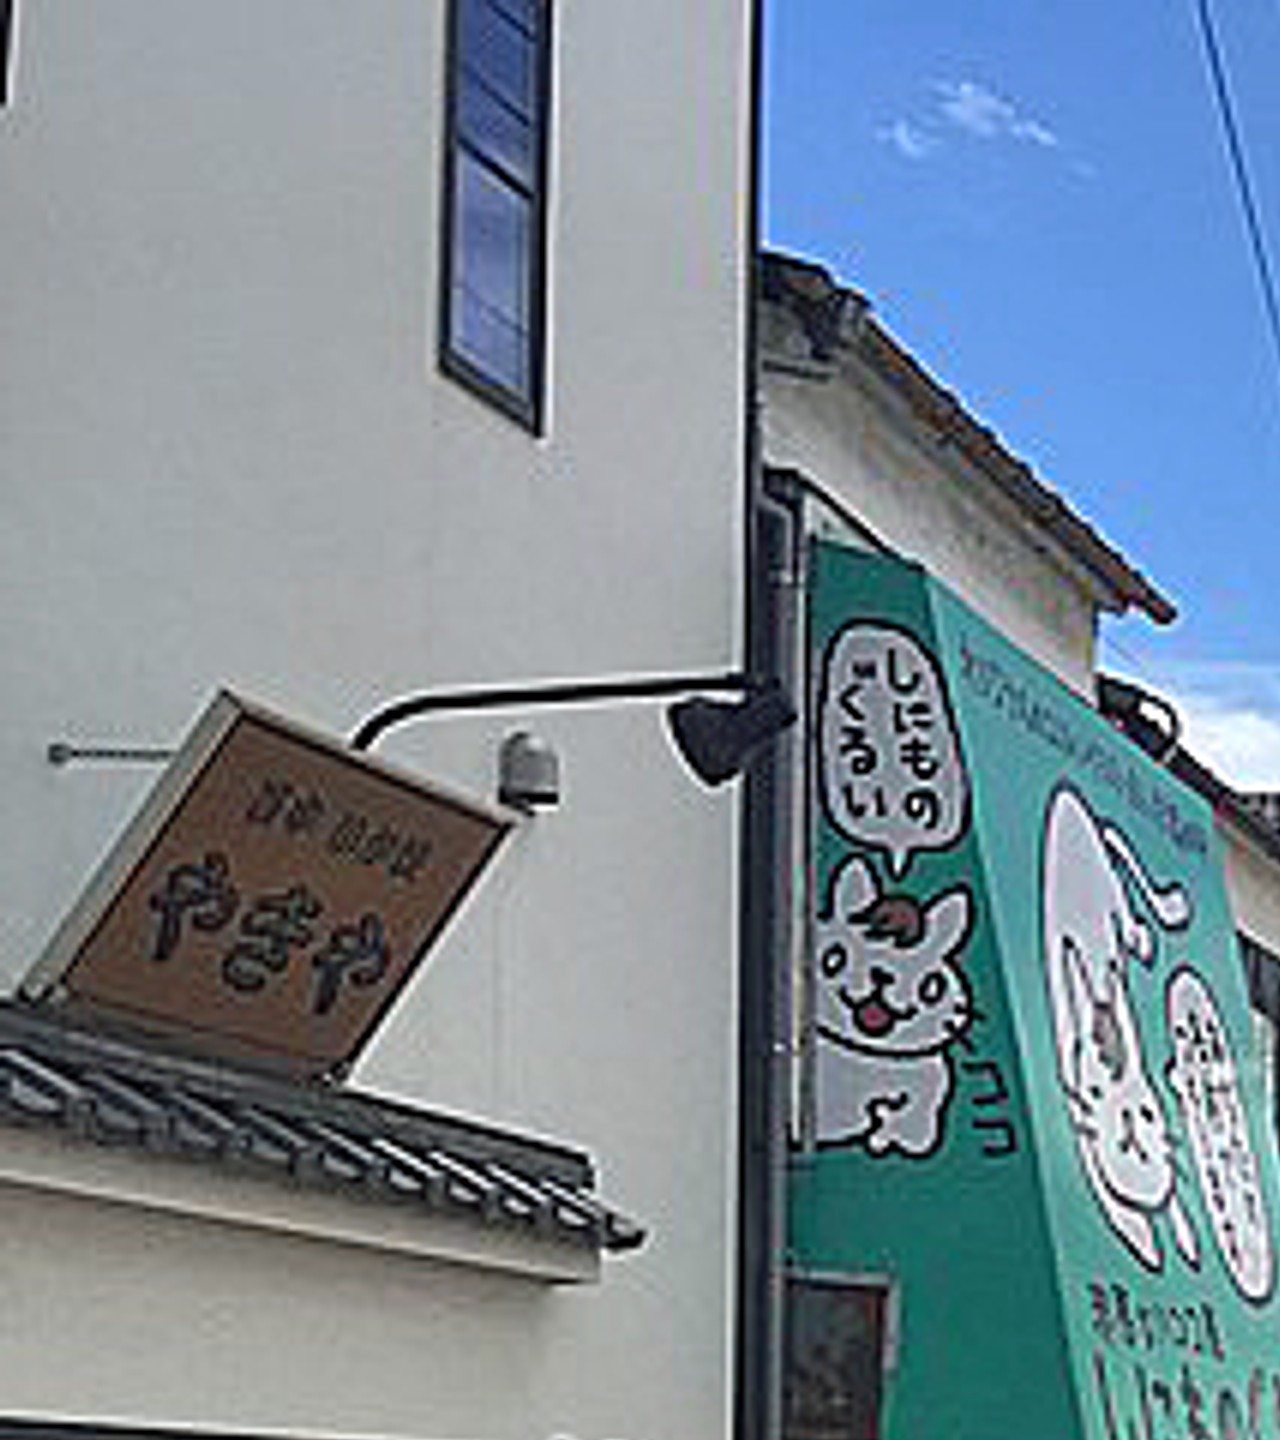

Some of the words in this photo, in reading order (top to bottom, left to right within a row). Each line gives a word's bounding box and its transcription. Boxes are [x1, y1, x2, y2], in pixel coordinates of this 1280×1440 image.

[838, 658, 886, 820] ぐるい
[886, 646, 940, 830] しにもの
[148, 852, 392, 1016] やきや
